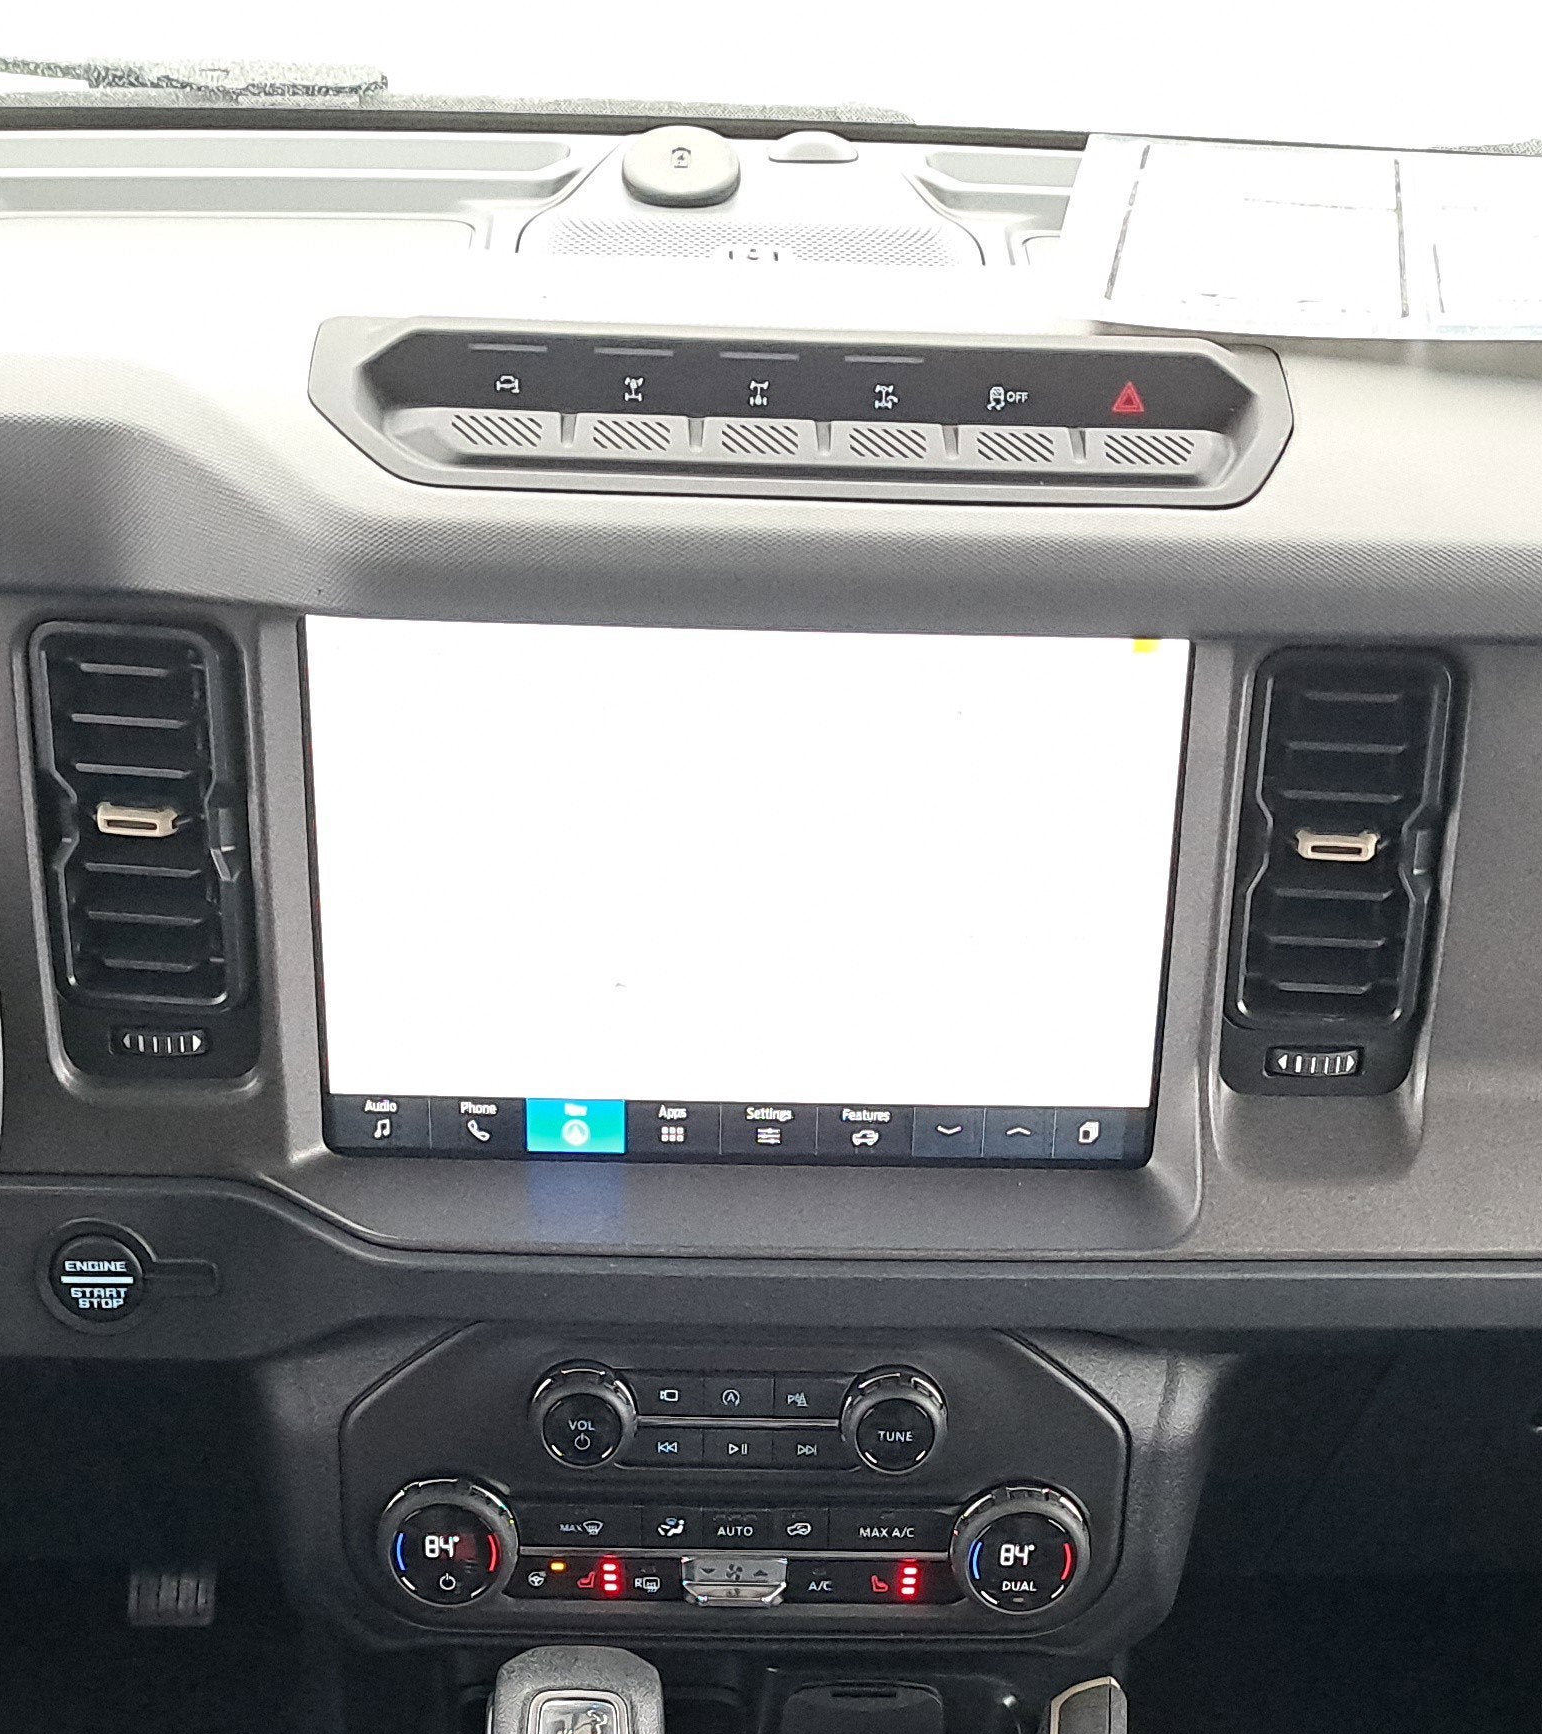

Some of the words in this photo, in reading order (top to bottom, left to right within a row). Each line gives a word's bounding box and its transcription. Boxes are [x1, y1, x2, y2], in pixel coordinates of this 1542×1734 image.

[1006, 391, 1030, 404] OFF
[364, 1099, 398, 1114] Audio
[460, 1101, 498, 1115] Phone
[658, 1104, 687, 1120] Apps
[746, 1107, 793, 1121] Settings
[842, 1108, 891, 1123] Features
[64, 1260, 128, 1272] ENGINE
[70, 1287, 128, 1298] START
[78, 1298, 124, 1309] STOP
[568, 1420, 595, 1431] VOL
[877, 1430, 913, 1442] TUNE
[559, 1523, 582, 1532] MAX
[717, 1526, 754, 1537] AUTO
[859, 1527, 889, 1538] MAX
[890, 1527, 915, 1538] A/C
[809, 1580, 832, 1592] A/C
[1002, 1581, 1037, 1591] DUAL
